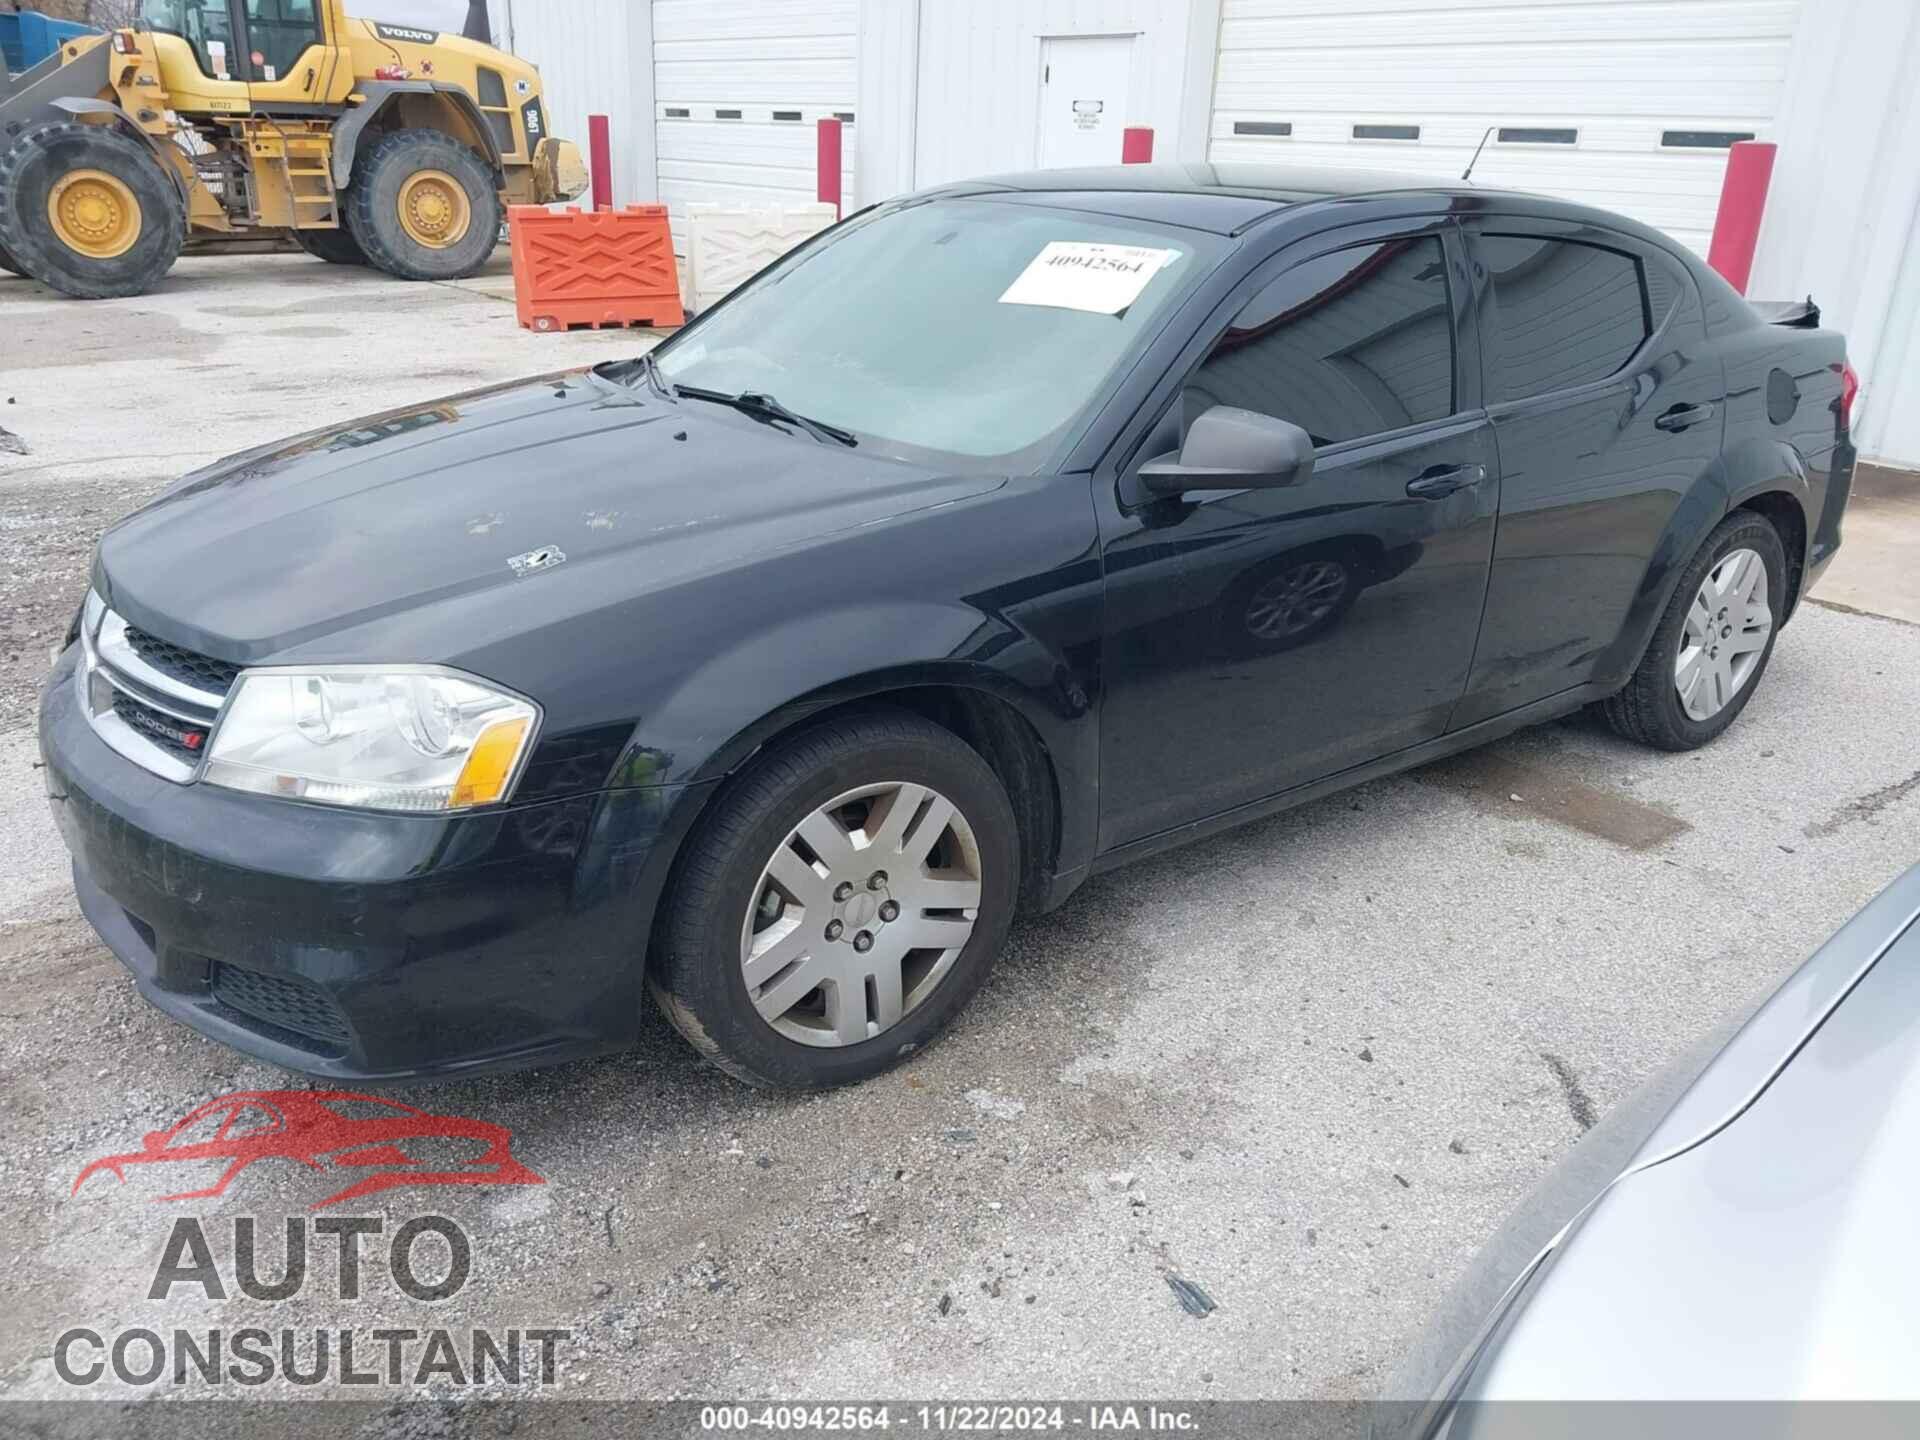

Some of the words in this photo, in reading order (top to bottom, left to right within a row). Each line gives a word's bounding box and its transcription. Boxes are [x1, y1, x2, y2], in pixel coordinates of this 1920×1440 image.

[379, 26, 433, 41] VOLVO
[526, 110, 540, 133] L90G
[1044, 255, 1145, 273] 40942564
